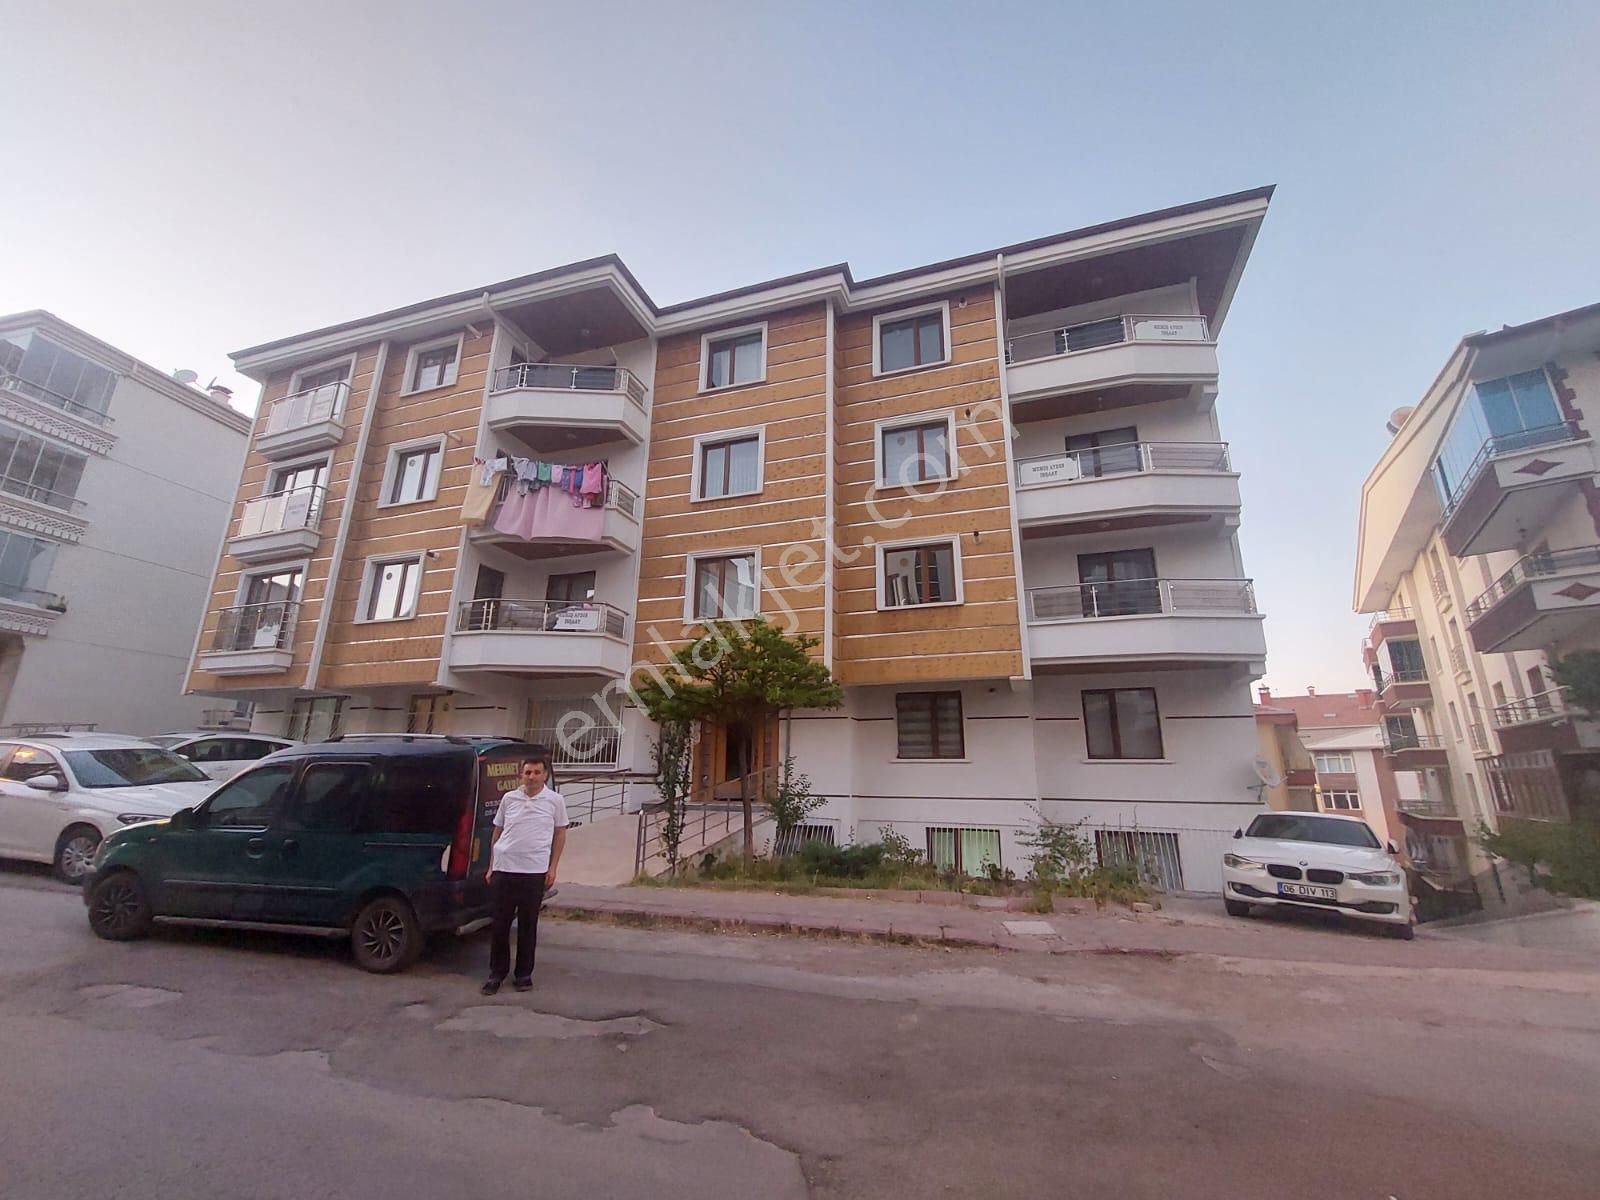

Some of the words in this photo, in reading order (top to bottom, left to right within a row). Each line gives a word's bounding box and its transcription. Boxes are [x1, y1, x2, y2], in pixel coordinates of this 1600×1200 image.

[1283, 883, 1295, 894] 06
[1300, 886, 1317, 896] DIV
[1321, 888, 1335, 898] 113
